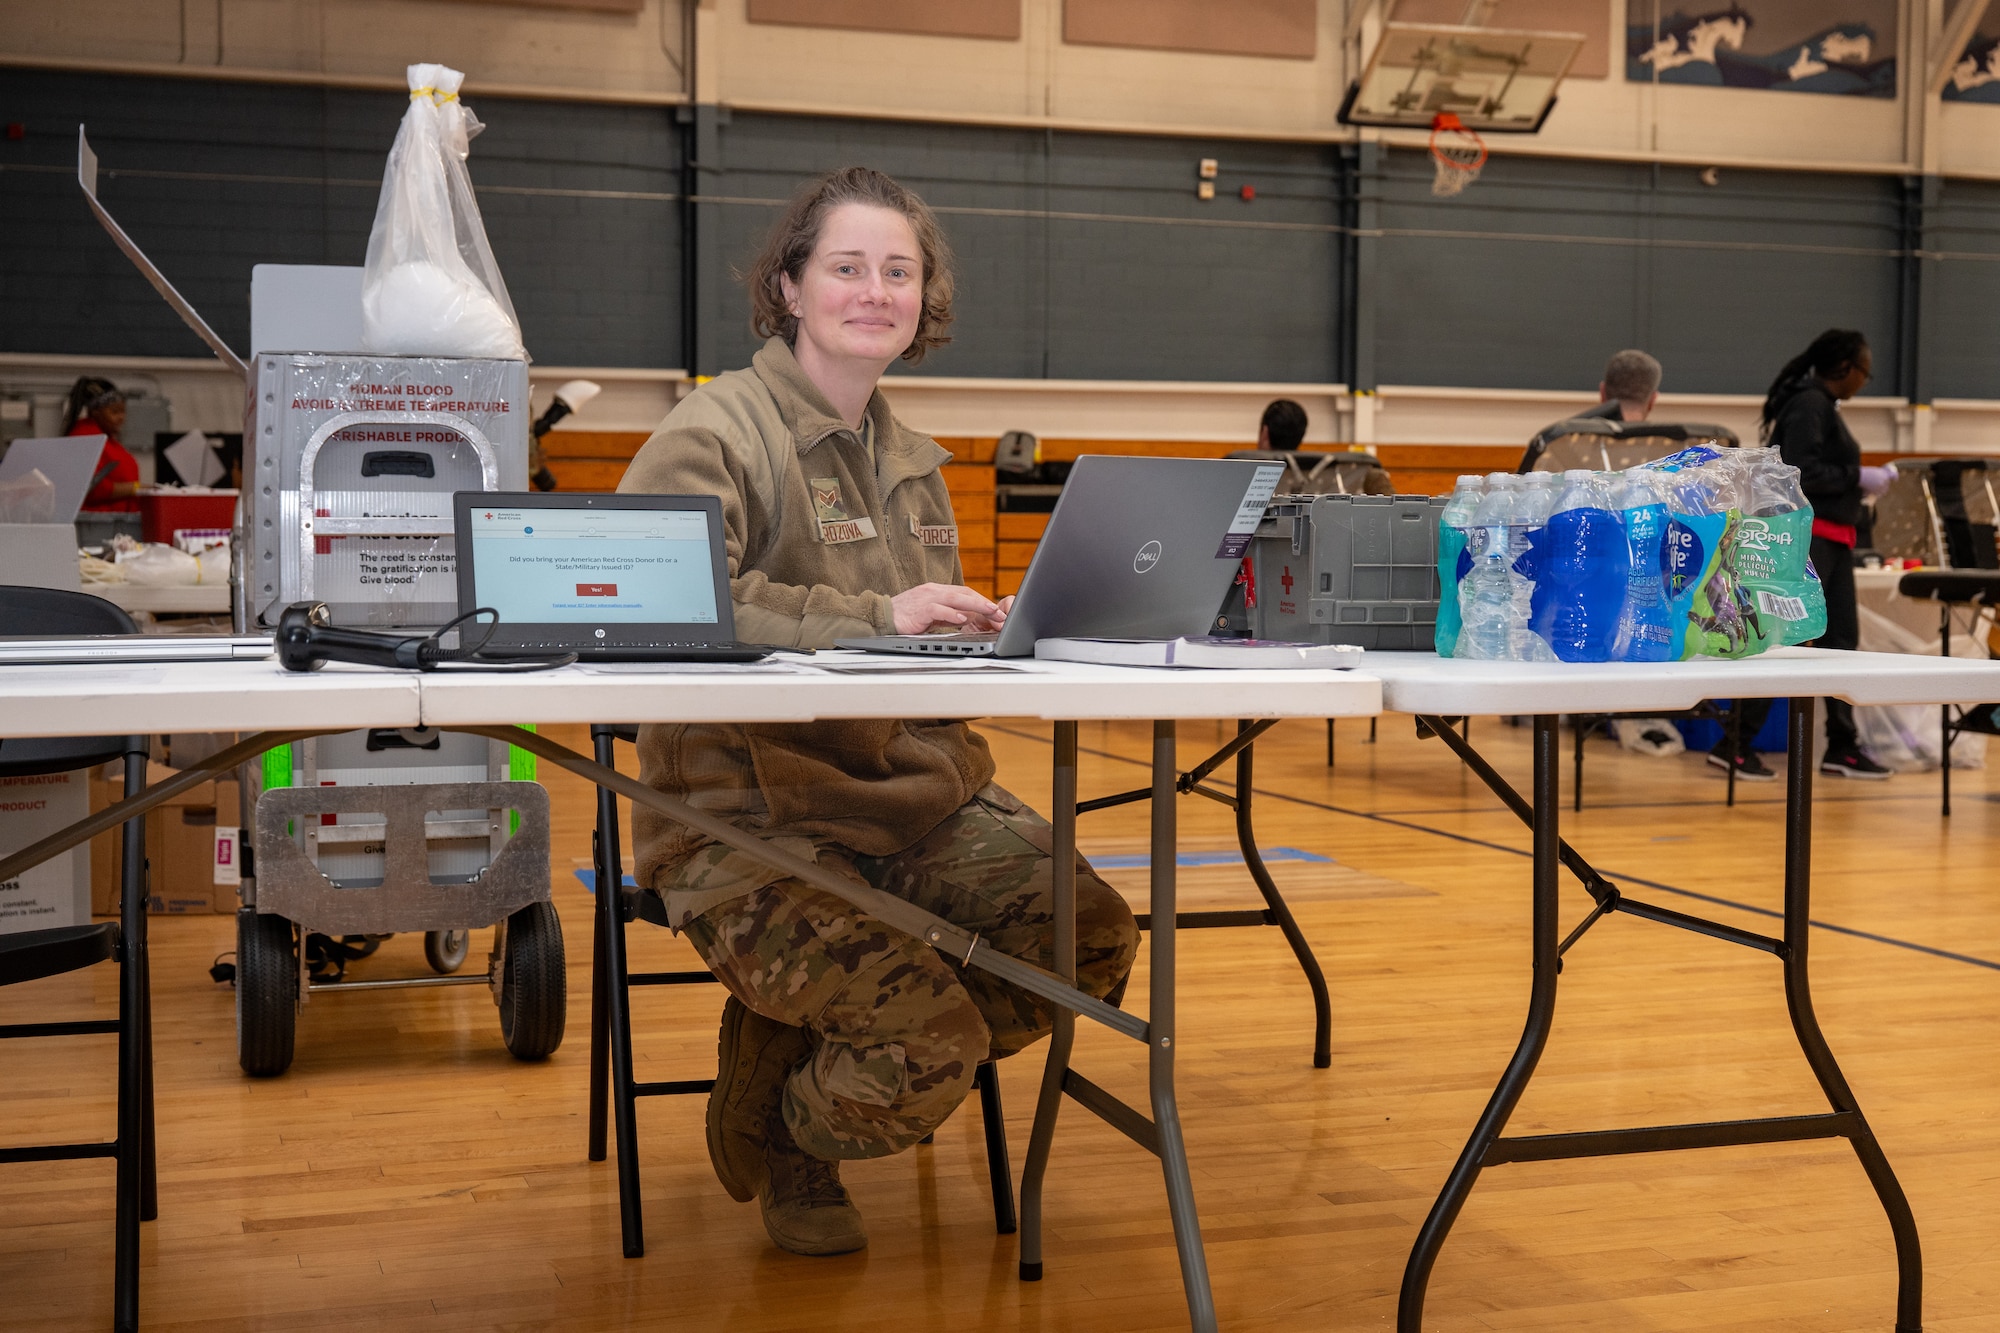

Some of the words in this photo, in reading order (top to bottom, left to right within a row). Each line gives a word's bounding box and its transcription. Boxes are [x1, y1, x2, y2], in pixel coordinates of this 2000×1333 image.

[350, 384, 402, 396] HUMAN
[406, 384, 454, 396] BLOOD
[291, 399, 334, 410] AVOID
[338, 400, 406, 412] EXTREME
[410, 401, 510, 412] TEMPERATURE
[332, 431, 414, 443] ERISHABLE
[416, 432, 465, 443] PRODU
[1631, 508, 1652, 524] 24
[360, 553, 378, 562] The
[381, 554, 405, 562] need
[407, 554, 416, 562] is
[418, 554, 456, 562] constan
[536, 556, 554, 564] bring
[1137, 552, 1157, 561] DELL
[1740, 554, 1762, 562] MIRA
[1764, 556, 1775, 565] LA
[360, 564, 378, 573] The
[381, 564, 438, 575] gratification
[440, 565, 449, 573] is
[555, 564, 600, 572] State/Military
[1628, 567, 1646, 577] AGUA
[1738, 561, 1776, 574] PELÍCULA
[360, 576, 382, 584] Give
[1628, 576, 1660, 588] PURIFICAD
[0, 774, 70, 788] MPERATURE
[364, 845, 386, 854] Give
